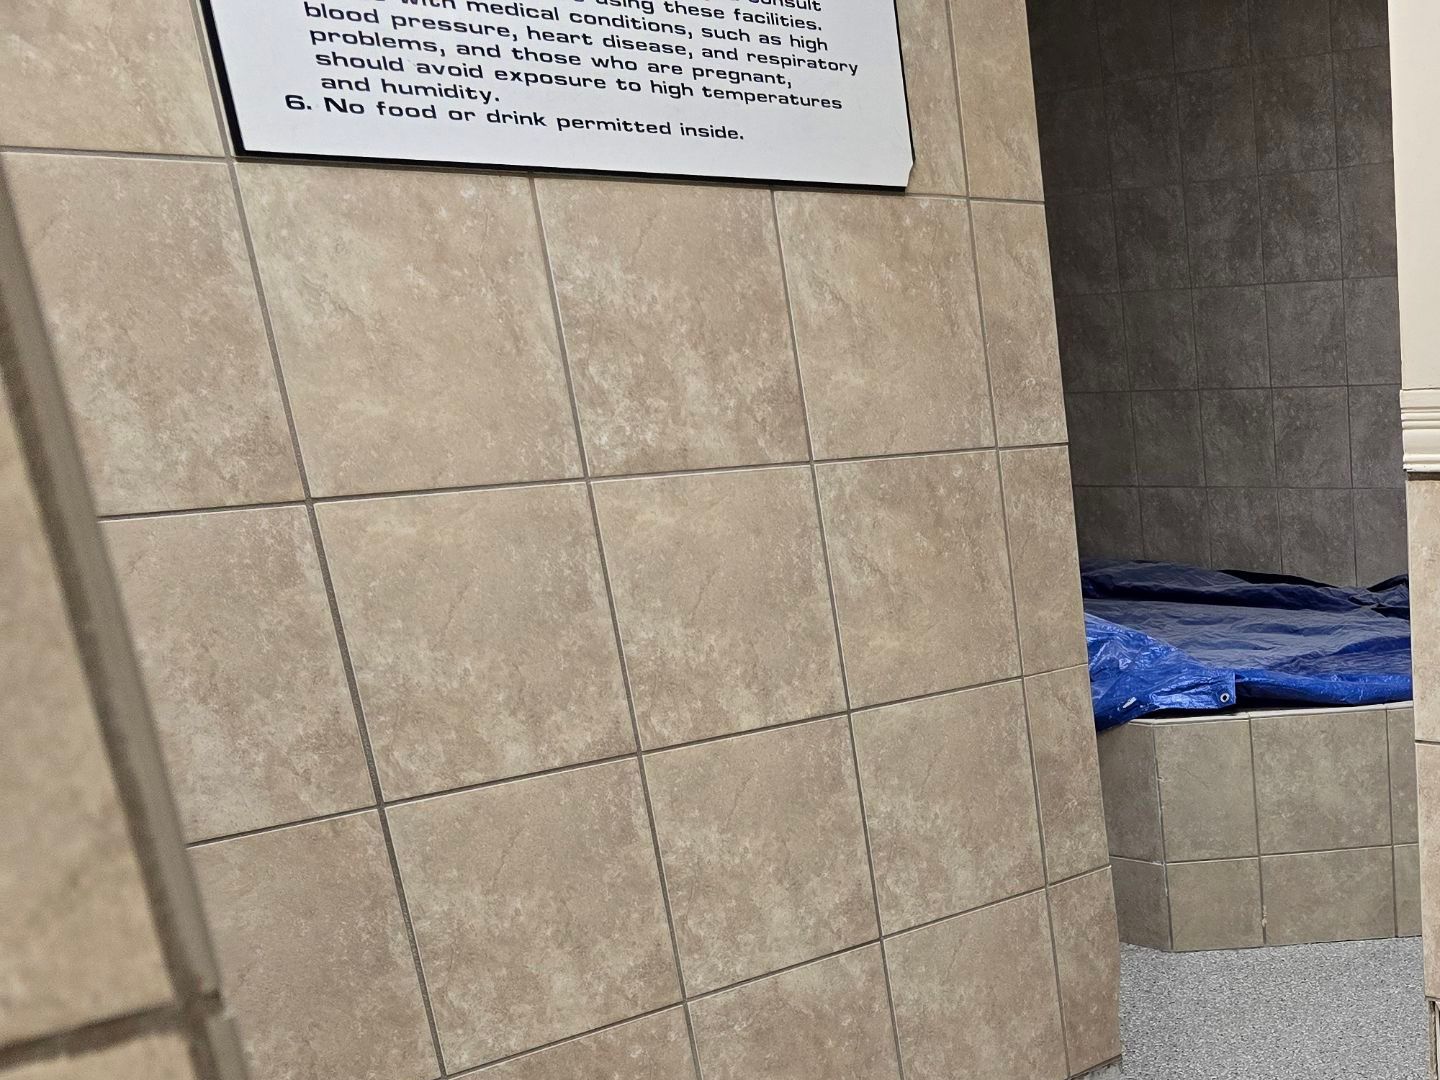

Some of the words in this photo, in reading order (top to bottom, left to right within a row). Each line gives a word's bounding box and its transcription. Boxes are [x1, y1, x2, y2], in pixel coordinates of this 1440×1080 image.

[304, 2, 379, 23] blood
[392, 16, 518, 41] pressure,
[526, 26, 592, 45] heart
[602, 35, 693, 59] disease,
[701, 48, 738, 60] and
[747, 53, 858, 76] respiratory
[466, 1, 559, 20] medical
[569, 13, 692, 39] conditions,
[701, 28, 750, 42] such
[759, 35, 782, 46] as
[789, 35, 827, 53] high
[663, 1, 724, 19] these
[733, 9, 822, 31] facilities.
[310, 30, 445, 56] problems,
[457, 45, 500, 58] and
[512, 47, 581, 65] those
[591, 56, 637, 70] who
[647, 63, 682, 74] are
[692, 68, 792, 89] pregnant,
[315, 52, 404, 71] should
[416, 63, 483, 78] avoid
[494, 71, 605, 88] exposure
[615, 79, 641, 91] to
[650, 80, 693, 99] high
[702, 87, 842, 109] temperatures
[321, 77, 370, 91] and
[381, 79, 499, 104] humidity.
[285, 95, 312, 110] 6.
[324, 97, 365, 114] No
[377, 102, 436, 118] food
[449, 111, 476, 121] or
[486, 110, 547, 126] drink
[557, 118, 671, 134] permitted
[680, 126, 744, 139] inside.
